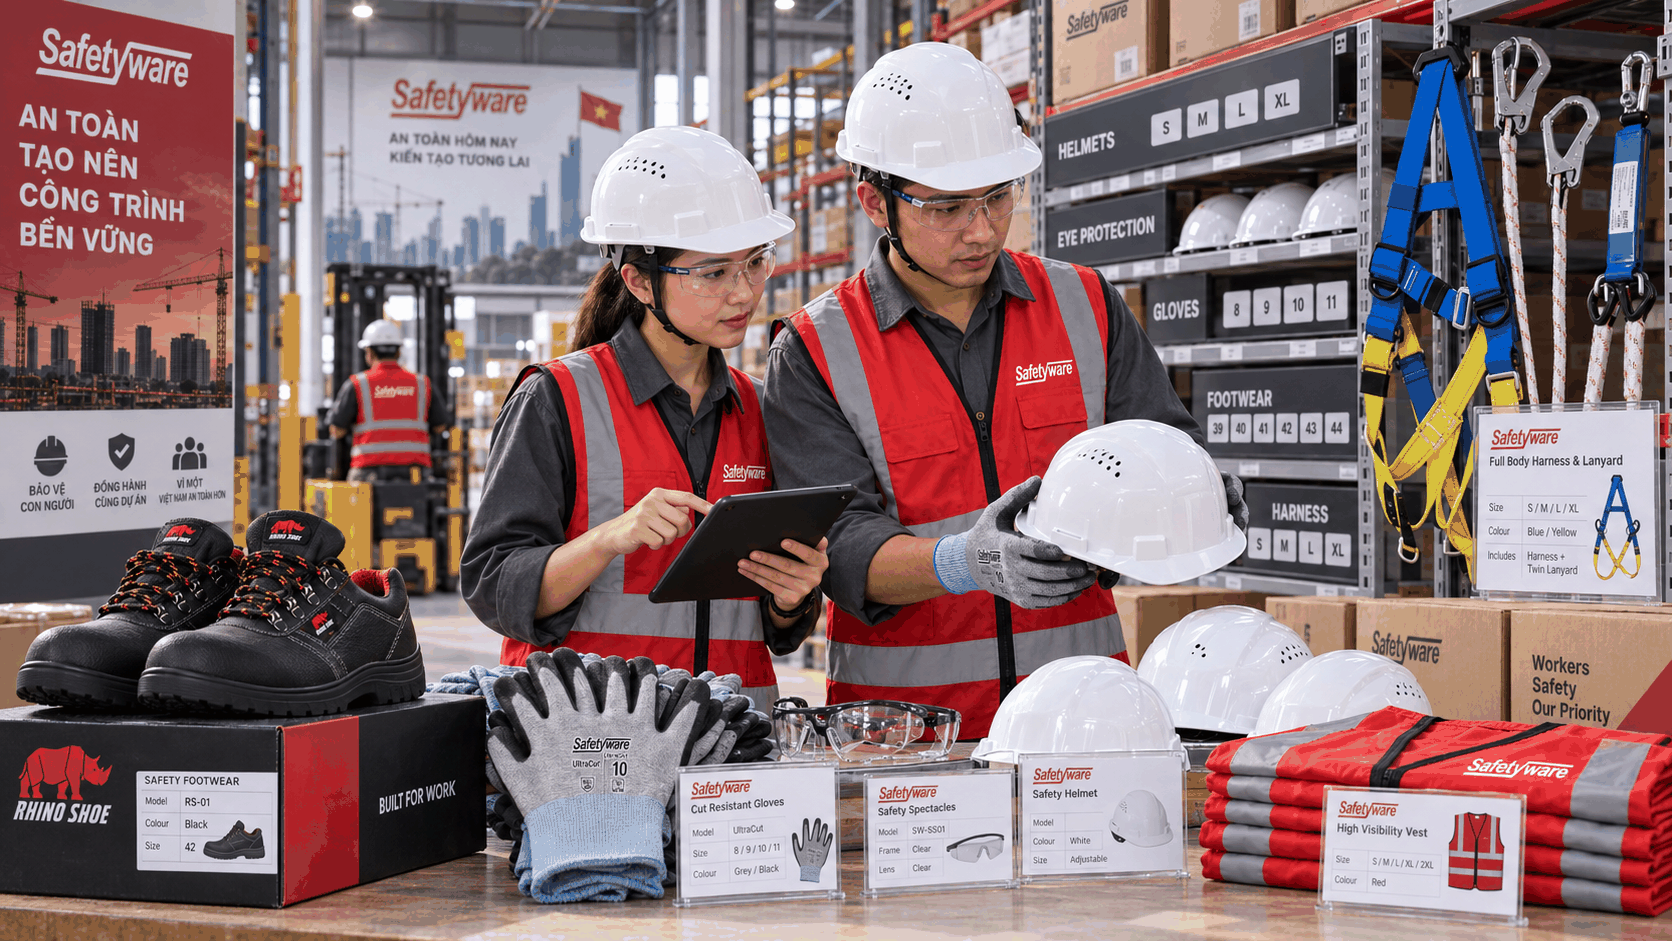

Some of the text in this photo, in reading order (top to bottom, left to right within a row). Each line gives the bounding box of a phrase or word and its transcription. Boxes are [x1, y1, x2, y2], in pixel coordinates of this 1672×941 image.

[1065, 0, 1129, 41] Safetyware
[36, 28, 192, 87] Safetyware
[390, 78, 530, 119] Safetyware
[19, 104, 138, 142] AN TOÀN
[1058, 92, 1290, 160] HELMETS S M L XL
[389, 131, 518, 148] AN TOÀN HÔM NAY
[19, 142, 138, 179] TẠO NÊN
[427, 152, 454, 167] TẠO
[458, 153, 505, 167] TƯƠNG
[509, 156, 530, 167] LAI
[20, 179, 185, 222] CÔNG TRÌNH
[20, 216, 153, 256] BỀN VỮNG
[1058, 215, 1155, 248] EYE PROTECTION
[1153, 295, 1337, 321] GLOVES 8 9 10 11
[1015, 359, 1073, 386] Safetyware
[1207, 390, 1272, 408] FOOTWEAR
[1213, 422, 1343, 435] 39 40 41 42 43 44
[1490, 428, 1561, 450] Safetyware
[1489, 455, 1623, 469] Full Body Harness & Lanyard
[722, 464, 767, 483] Safetyware
[29, 482, 65, 496] BẢO VỆ
[20, 501, 41, 512] CON
[1272, 502, 1329, 524] HARNESS
[1488, 503, 1579, 514] Size S M L XL
[1488, 526, 1577, 538] Colour Blue Yellow
[1256, 538, 1344, 557] S M L XL
[1487, 550, 1516, 561] Includes
[1527, 551, 1559, 561] Harness
[1527, 564, 1578, 576] Twin Lanyard
[1372, 630, 1443, 665] Safetyware
[1532, 653, 1590, 676] Workers
[1532, 677, 1577, 700] Safety
[1532, 699, 1611, 727] Our Priority
[572, 737, 631, 753] Safetyware
[612, 761, 628, 776] 10
[1032, 767, 1094, 785] Safetyware
[1463, 758, 1574, 779] Safetyware
[144, 775, 240, 786] SAFETY FOOTWEAR
[379, 779, 456, 815] BUILT FOR WORK
[690, 779, 753, 800] Safetyware
[878, 785, 939, 803] Safetyware
[1032, 788, 1098, 801] Safety Helmet
[145, 797, 210, 807] Model RS-01
[691, 798, 785, 814] Cut Resistant Gloves
[878, 803, 956, 817] Safety Spectacles
[1337, 800, 1399, 819] Safetyware
[13, 800, 112, 825] RHINO SHOE
[145, 819, 208, 829] Colour Black
[692, 825, 764, 837] Model UltraCut
[878, 825, 945, 836] Model SW-SS01
[1032, 819, 1054, 827] Model
[1337, 822, 1428, 838] High Visibility Vest
[145, 841, 196, 852] Size 42
[1032, 836, 1091, 846] Colour White
[692, 843, 780, 858] Size 8 9 10 11
[878, 845, 931, 855] Frame Clear
[1033, 854, 1108, 865] Size Adjustable
[1335, 855, 1434, 870] Size S M L XL 2XL
[693, 864, 780, 879] Colour Grey Black
[878, 864, 931, 874] Lens Clear
[1334, 875, 1386, 887] Colour Red
